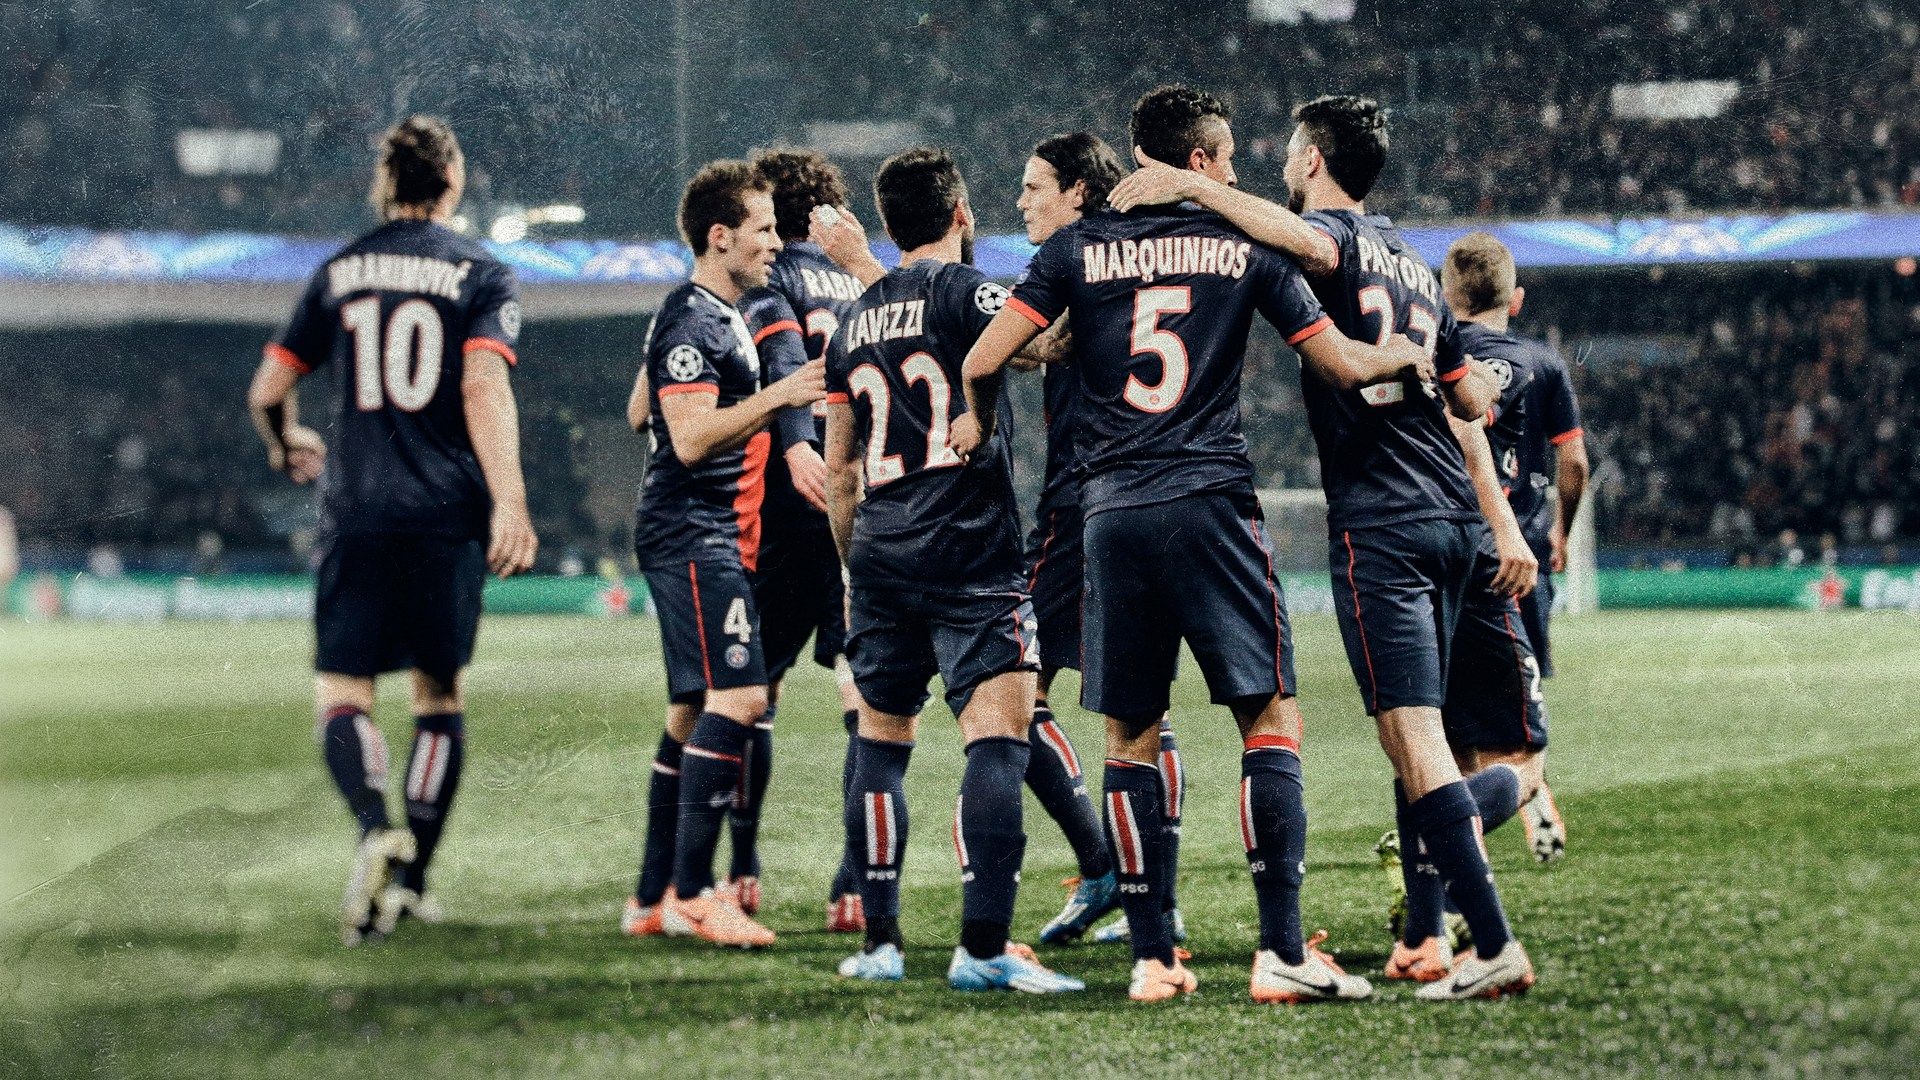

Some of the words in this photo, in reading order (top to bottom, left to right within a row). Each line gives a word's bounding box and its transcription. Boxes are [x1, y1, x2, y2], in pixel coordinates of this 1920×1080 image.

[1084, 237, 1251, 283] MARQUINHOS
[847, 299, 926, 354] LAVEZZI
[1123, 285, 1192, 414] 5
[341, 297, 444, 412] 10
[847, 351, 966, 487] 22
[724, 597, 752, 643] 4
[1120, 883, 1149, 893] PSG
